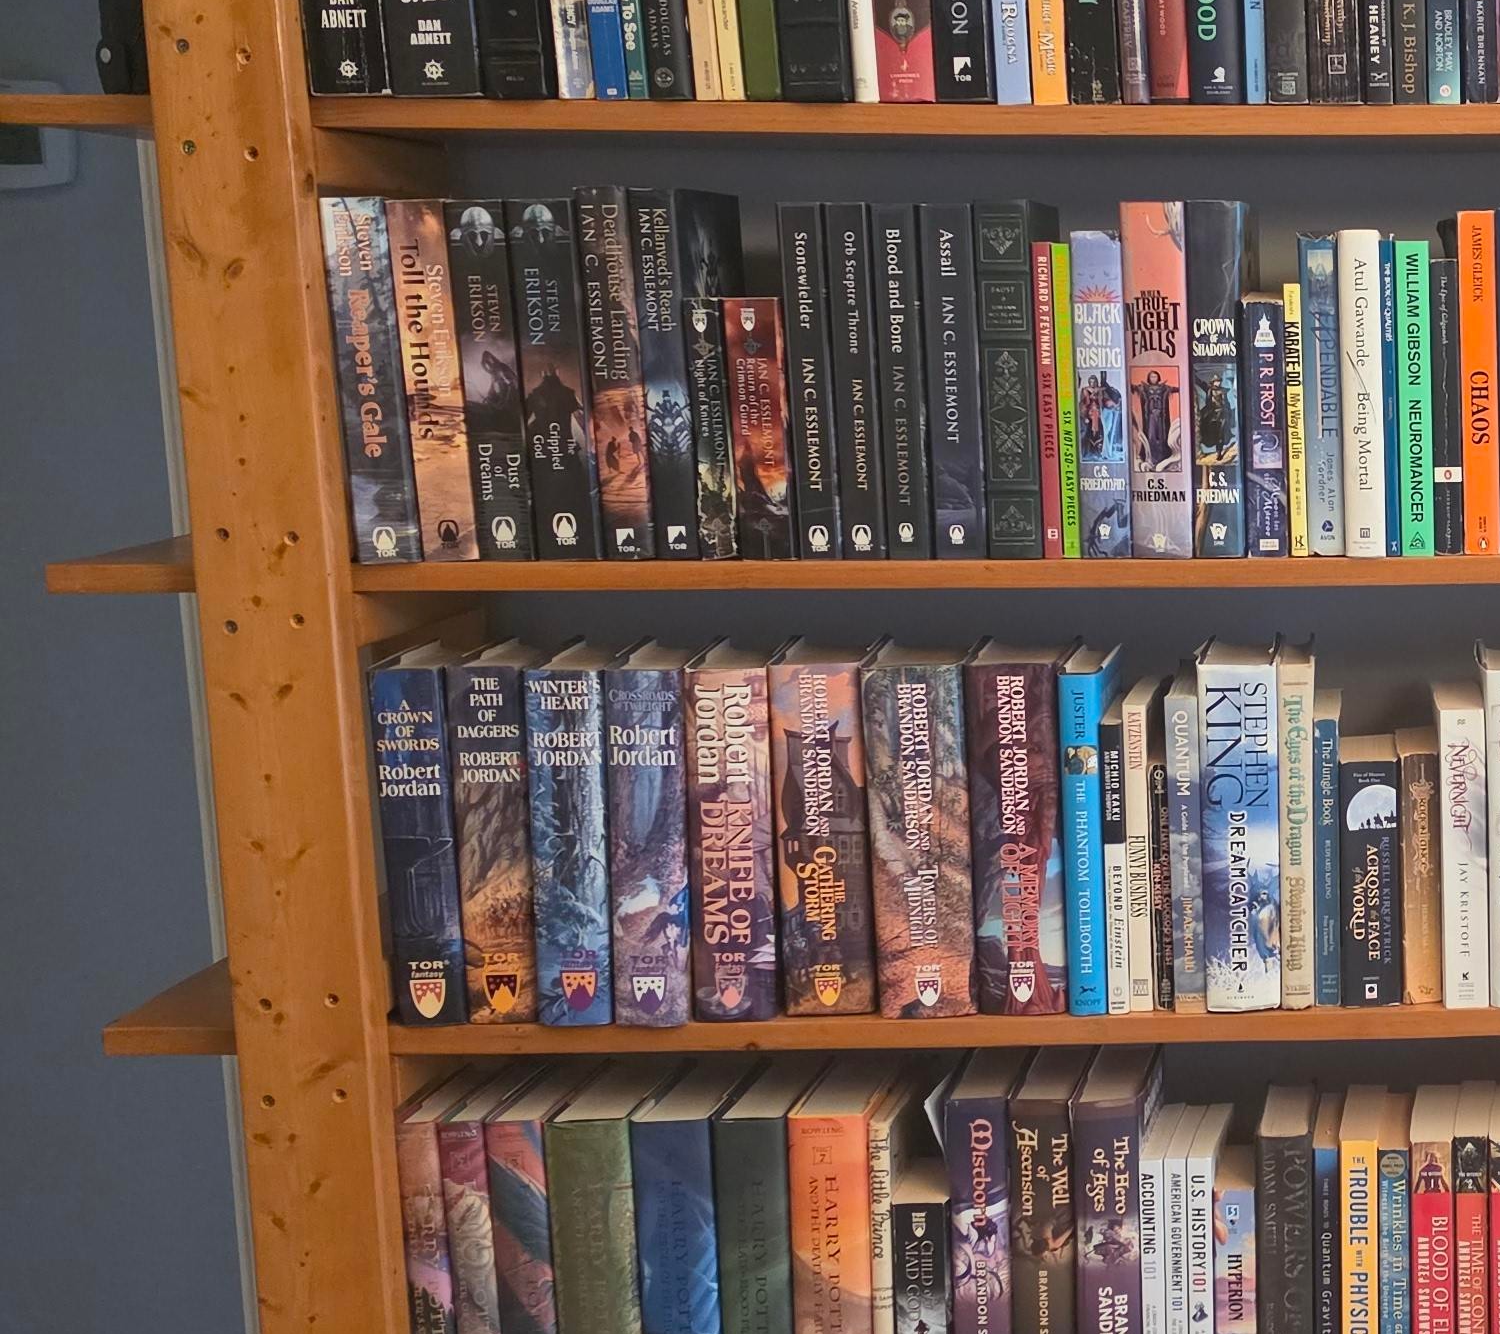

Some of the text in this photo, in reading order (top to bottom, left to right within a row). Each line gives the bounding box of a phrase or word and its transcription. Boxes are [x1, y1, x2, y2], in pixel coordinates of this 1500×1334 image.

[410, 33, 451, 45] ABNETT
[524, 268, 545, 345] ERIKSON
[601, 204, 631, 380] Deadhouse Landing
[1126, 304, 1180, 330] NIGHT
[1134, 294, 1169, 308] TRUE
[1405, 253, 1420, 386] WILLIAM GIBSON
[399, 239, 439, 439] Toll the Hounds
[1131, 331, 1175, 357] FALLS
[1193, 341, 1236, 356] SHADOWS
[346, 289, 387, 458] Reaper's Gale
[1469, 370, 1490, 445] CHAOS
[1409, 399, 1423, 523] NEUROMANCER
[529, 680, 600, 694] WINTER'S
[541, 696, 590, 710] HEART
[609, 726, 675, 745] Robert
[610, 748, 676, 766] Jordan
[1171, 710, 1190, 796] QUANTUM
[1205, 685, 1243, 809] KING
[1243, 682, 1268, 808] STEPHEN
[379, 764, 440, 780] Robert
[460, 768, 520, 783] JORDAN
[797, 863, 818, 922] STORM
[812, 846, 836, 941] GATHERING
[833, 879, 845, 902] THE
[1229, 811, 1247, 972] DREAMCATCHER
[1352, 887, 1364, 939] WORLD
[969, 1118, 993, 1228] Mistborn
[1349, 1168, 1368, 1245] TROUBLE
[1227, 1254, 1243, 1322] HYPERION
